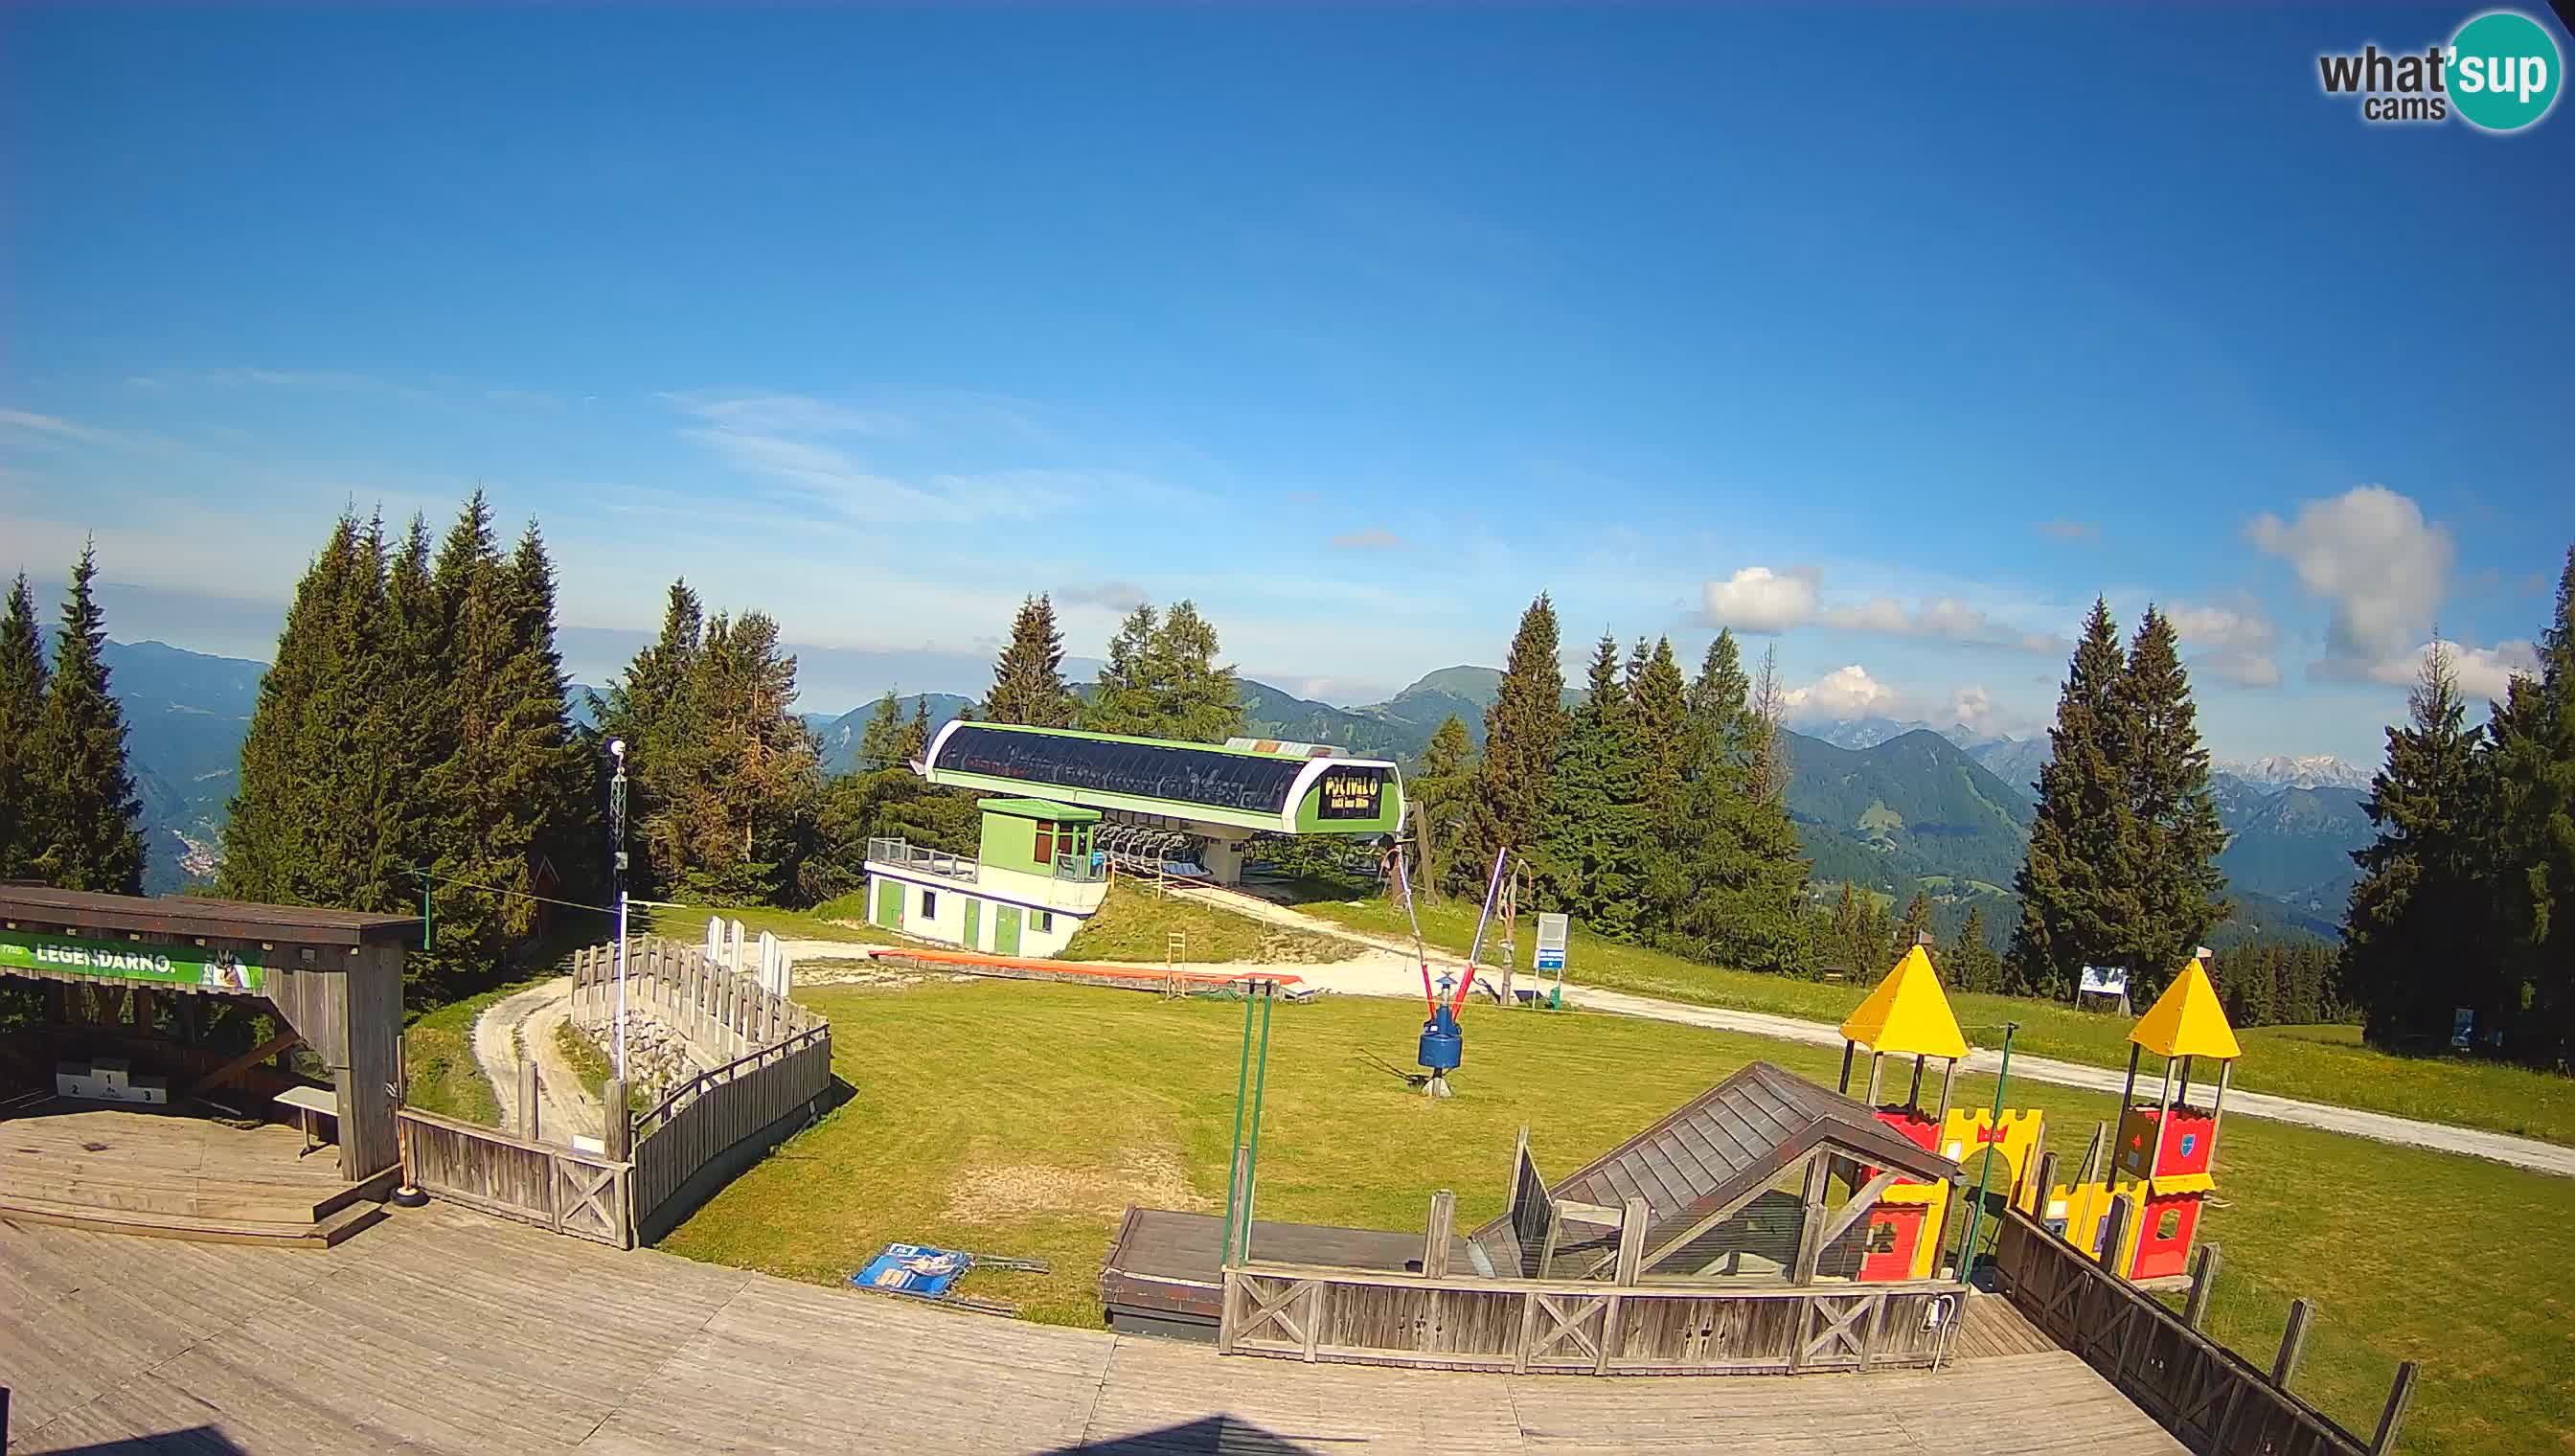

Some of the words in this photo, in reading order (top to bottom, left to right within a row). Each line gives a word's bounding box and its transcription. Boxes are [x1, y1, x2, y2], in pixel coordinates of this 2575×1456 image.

[106, 1073, 112, 1084] 1
[71, 1084, 80, 1095] 2
[144, 1090, 151, 1102] 3
